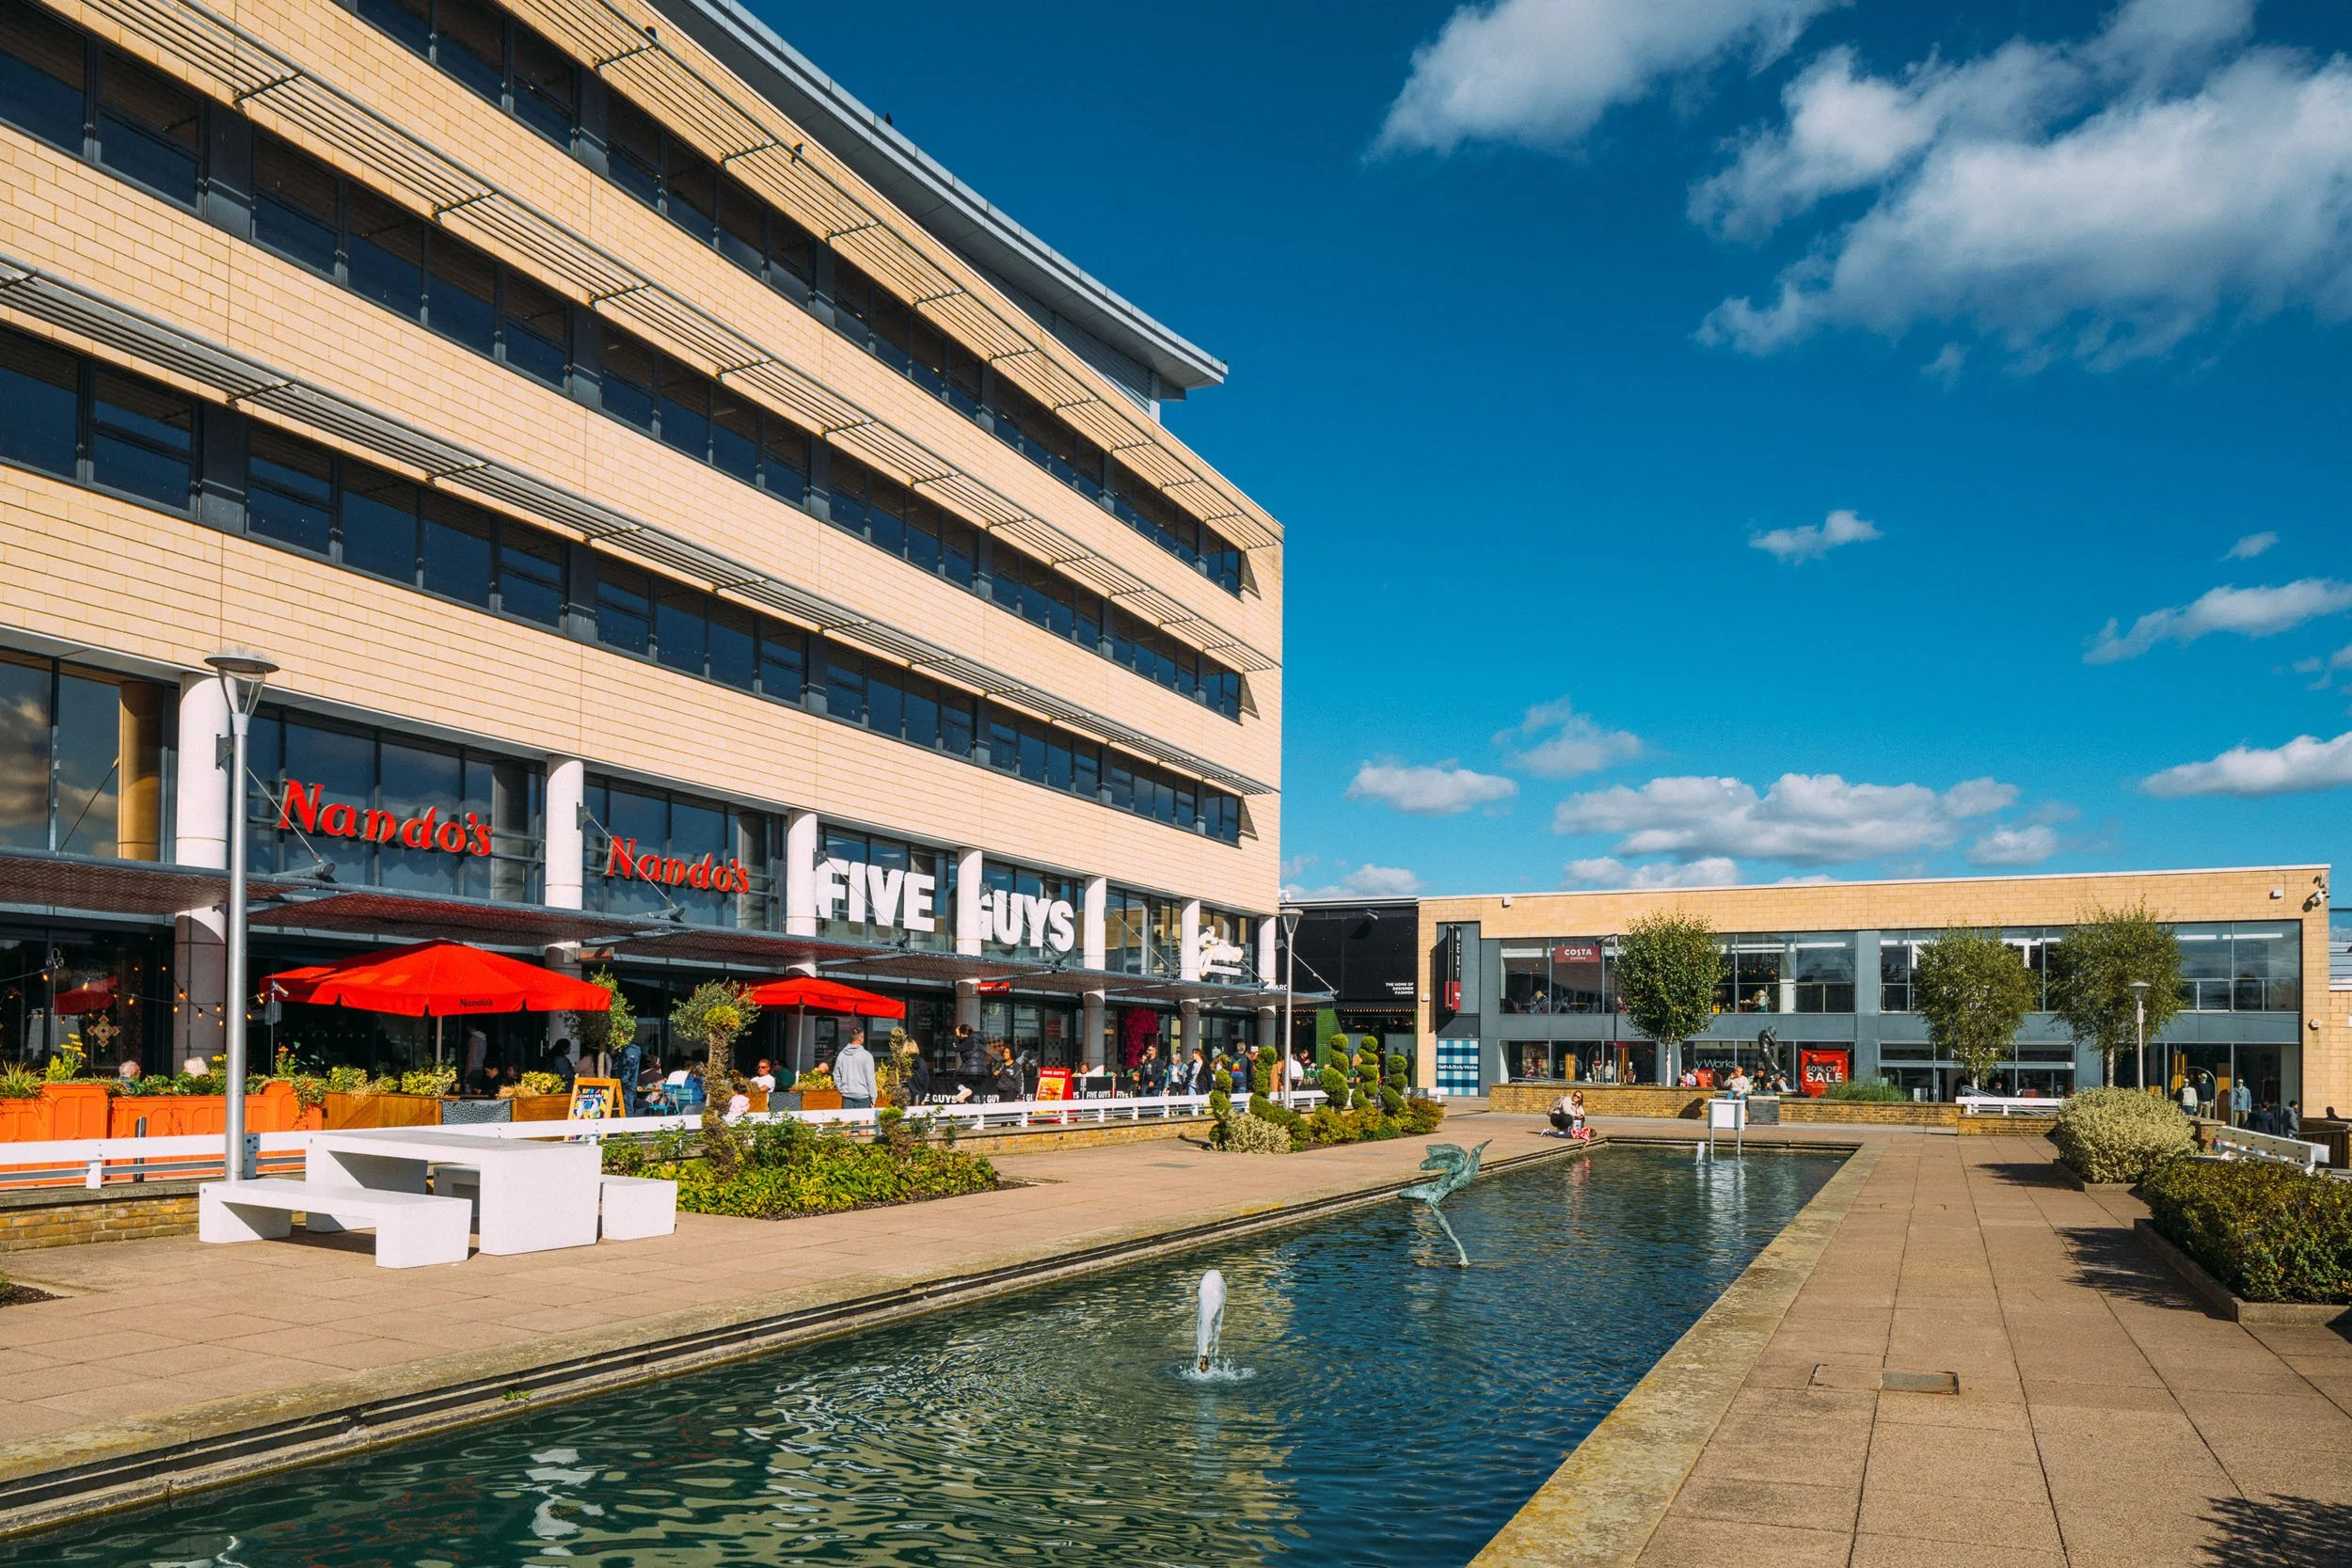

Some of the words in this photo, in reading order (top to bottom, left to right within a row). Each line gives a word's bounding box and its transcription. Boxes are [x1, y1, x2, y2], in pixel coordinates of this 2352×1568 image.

[276, 778, 493, 857] Nando's
[603, 835, 750, 894] Nando's
[816, 857, 935, 932] FIVE
[1564, 948, 1593, 957] COSTA
[1704, 1059, 1739, 1069] Works
[1805, 1071, 1843, 1083] SALE
[932, 1094, 957, 1103] GUYS
[986, 1094, 1000, 1103] GUY
[1098, 1090, 1111, 1099] GUYS
